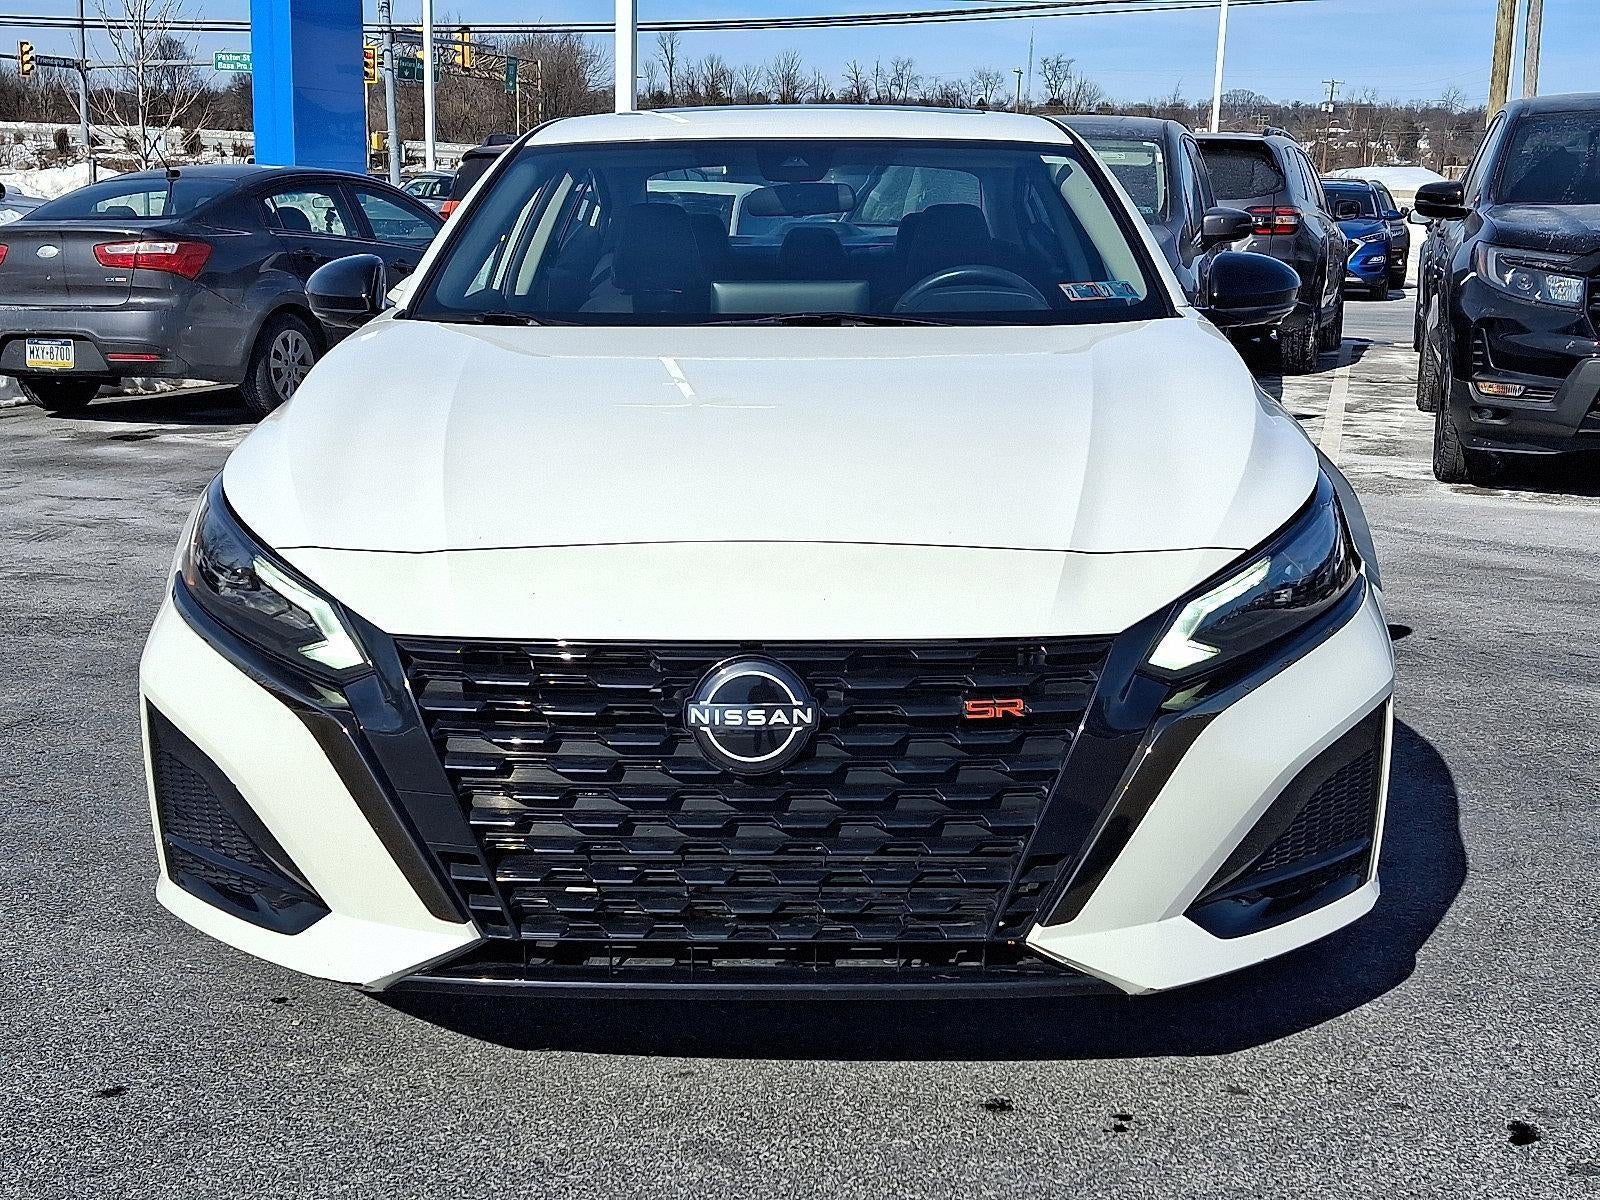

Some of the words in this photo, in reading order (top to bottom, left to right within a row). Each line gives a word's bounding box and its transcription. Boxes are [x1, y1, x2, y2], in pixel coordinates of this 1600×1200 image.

[236, 62, 248, 70] Pro
[690, 708, 812, 727] NISSAN
[965, 698, 1026, 719] SR
